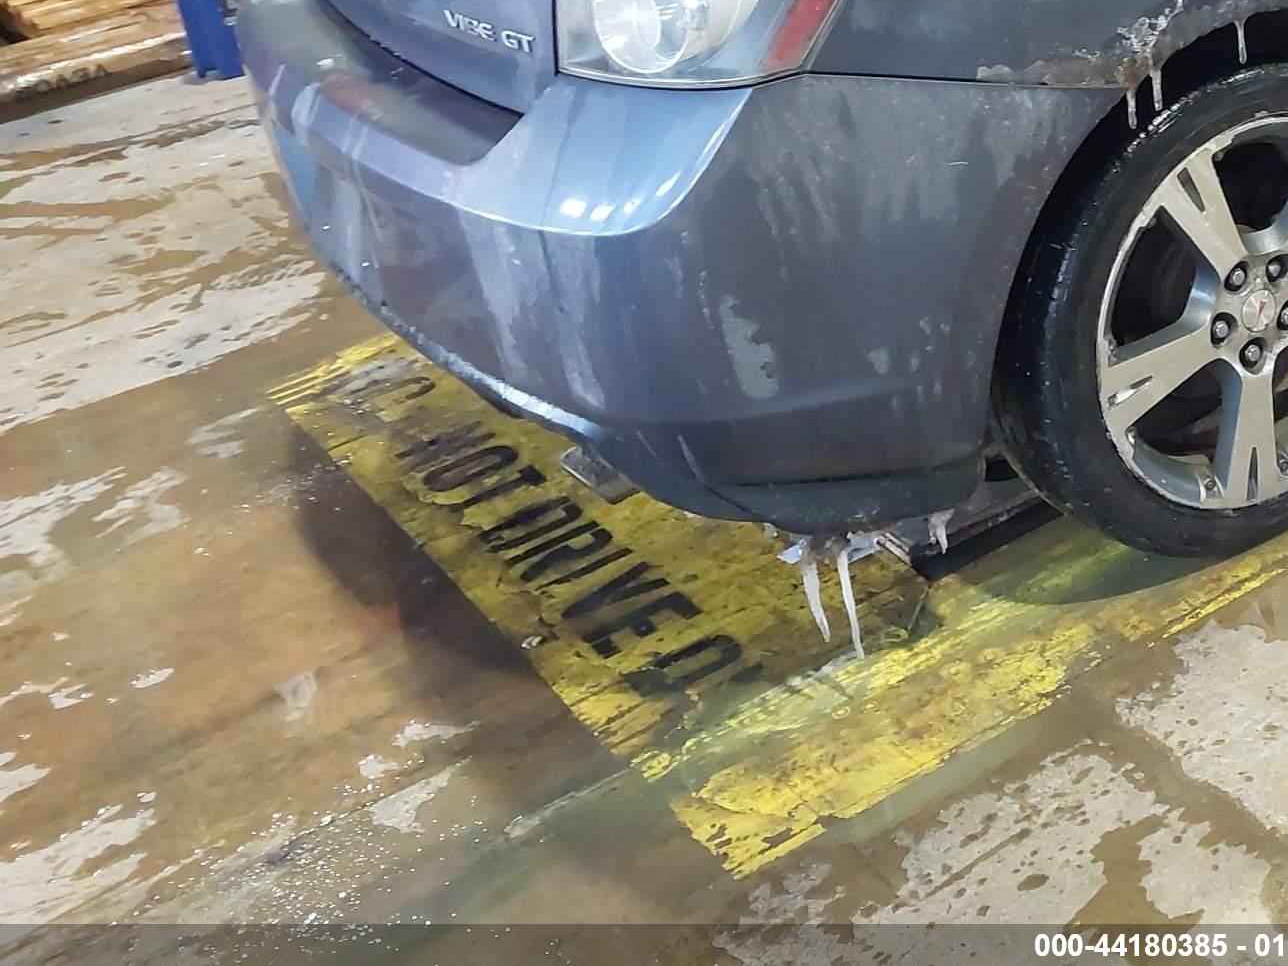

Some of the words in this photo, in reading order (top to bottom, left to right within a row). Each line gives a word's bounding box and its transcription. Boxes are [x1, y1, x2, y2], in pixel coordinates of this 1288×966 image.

[443, 9, 497, 42] VIBE
[501, 30, 536, 53] GT
[396, 421, 548, 514] NOT
[479, 495, 702, 660] DRIVE
